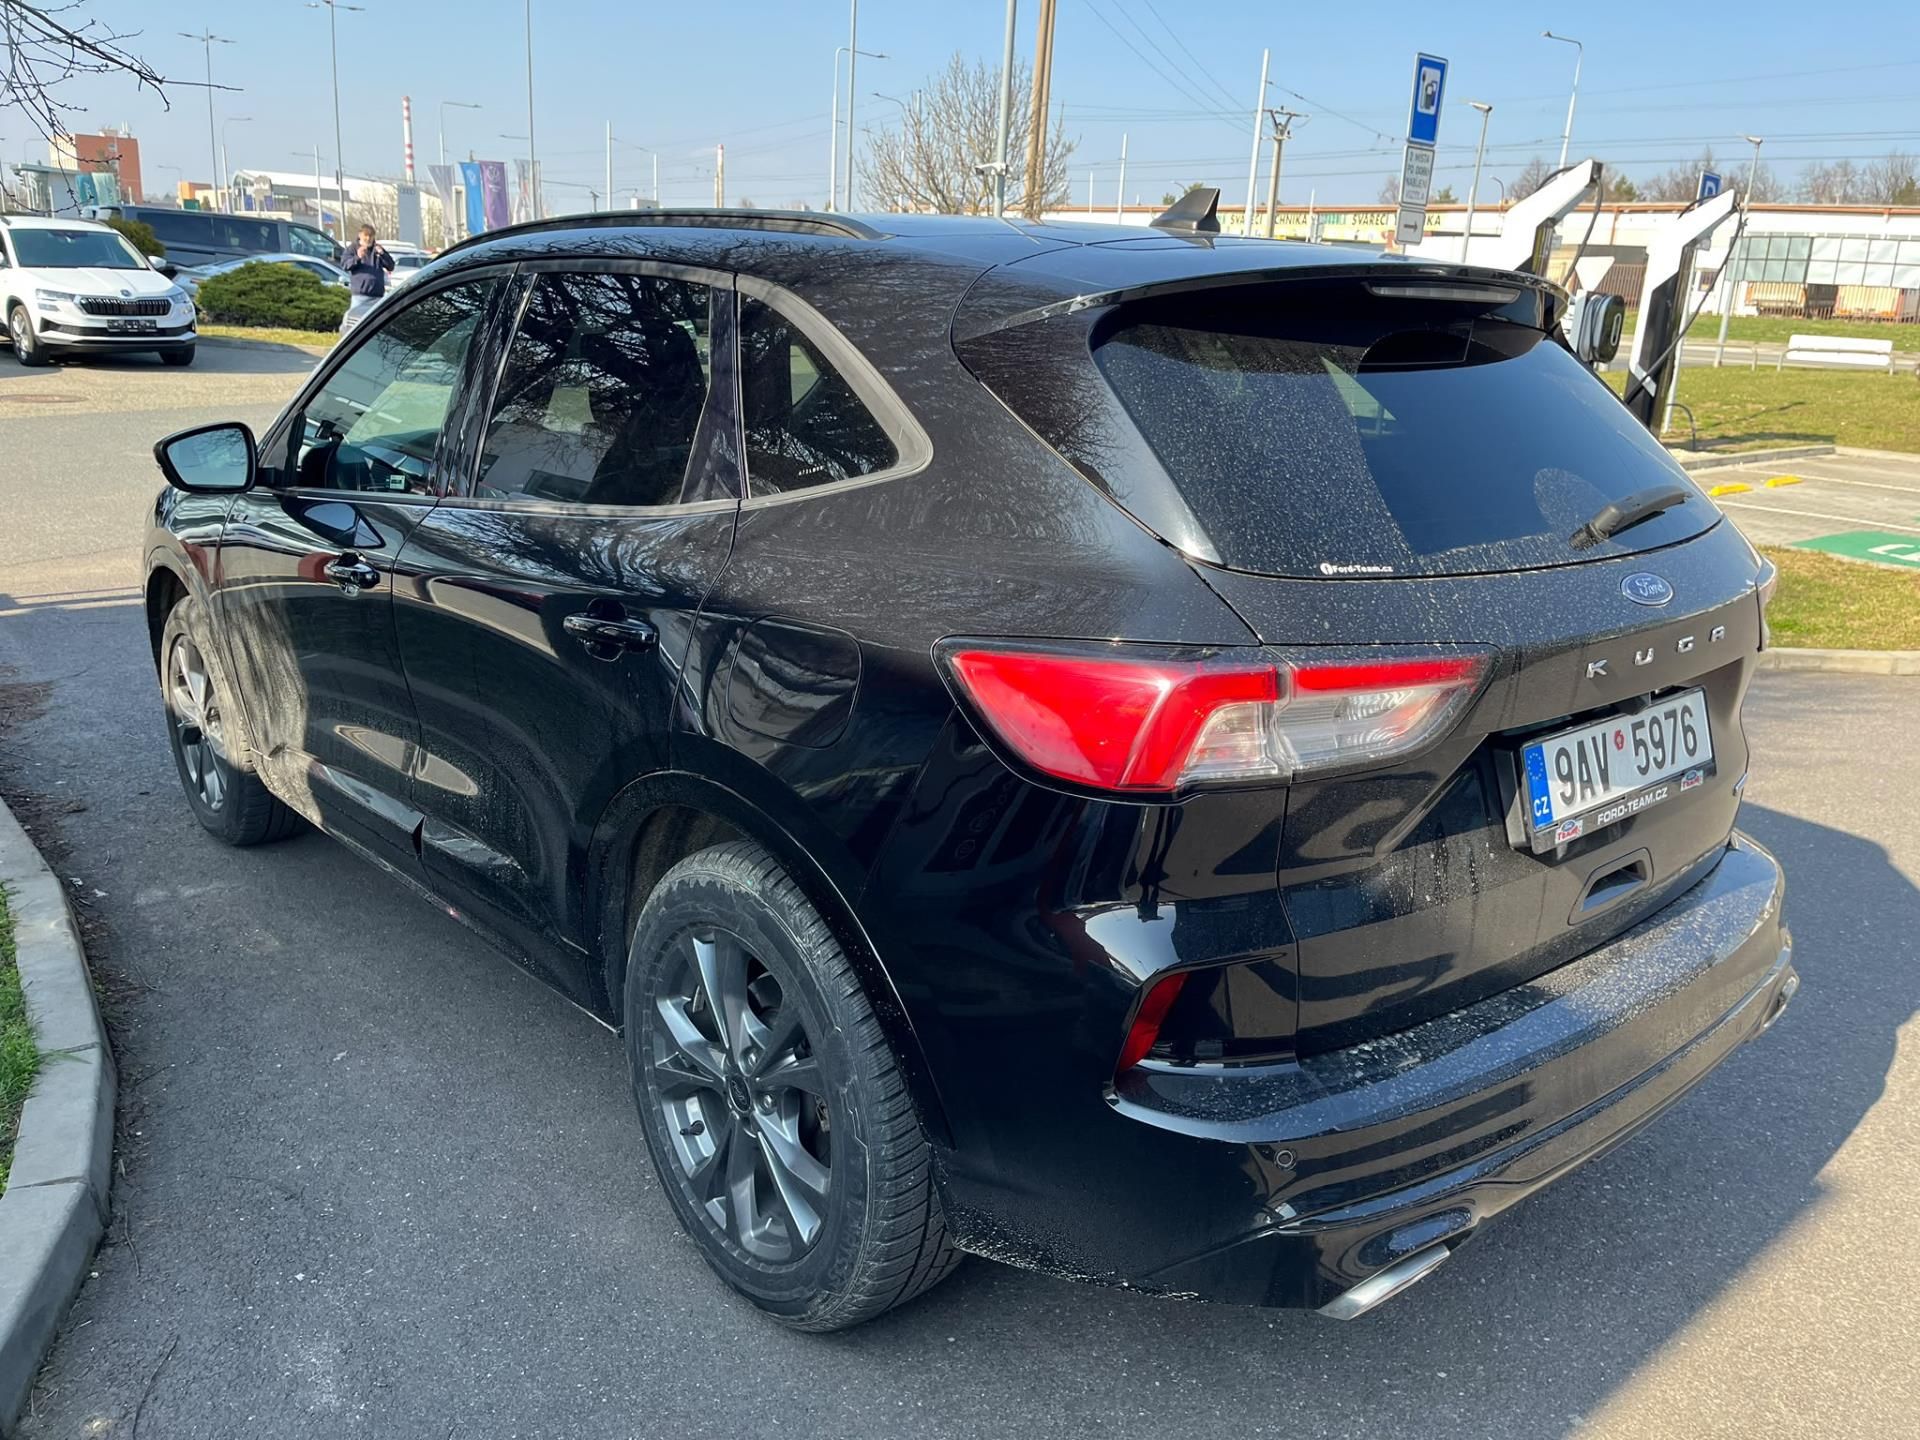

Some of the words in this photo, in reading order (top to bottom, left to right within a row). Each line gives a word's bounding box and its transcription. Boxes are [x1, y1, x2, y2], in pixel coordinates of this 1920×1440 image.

[1635, 577, 1666, 597] Ford
[1586, 625, 1726, 678] KUGA
[1554, 732, 1611, 806] 9AV
[1631, 704, 1698, 776] 5976
[1533, 796, 1550, 817] CZ
[1597, 787, 1668, 825] FORD-TEAM.CZ
